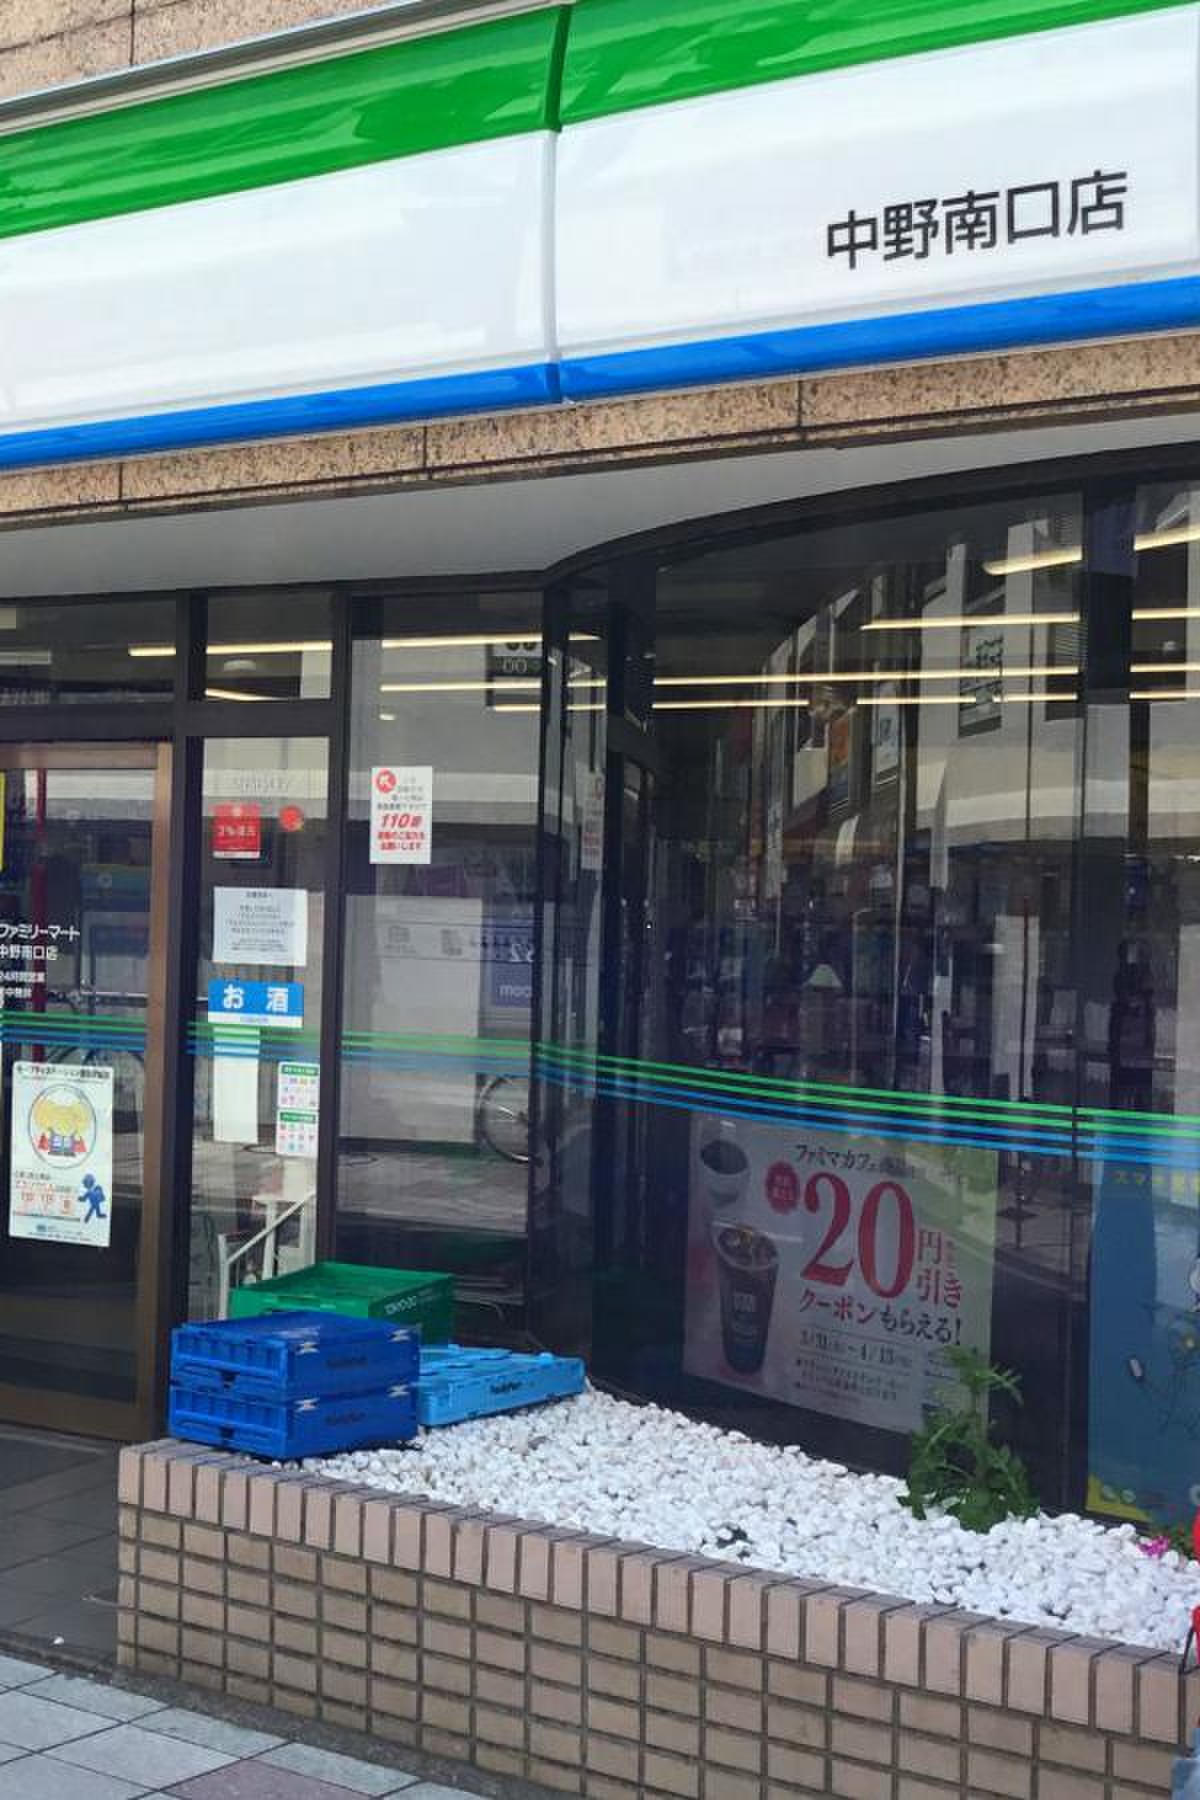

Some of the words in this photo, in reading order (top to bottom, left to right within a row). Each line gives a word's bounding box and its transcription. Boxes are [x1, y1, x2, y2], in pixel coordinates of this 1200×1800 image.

[826, 169, 1128, 270] 中野南口店
[801, 1171, 915, 1299] 20
